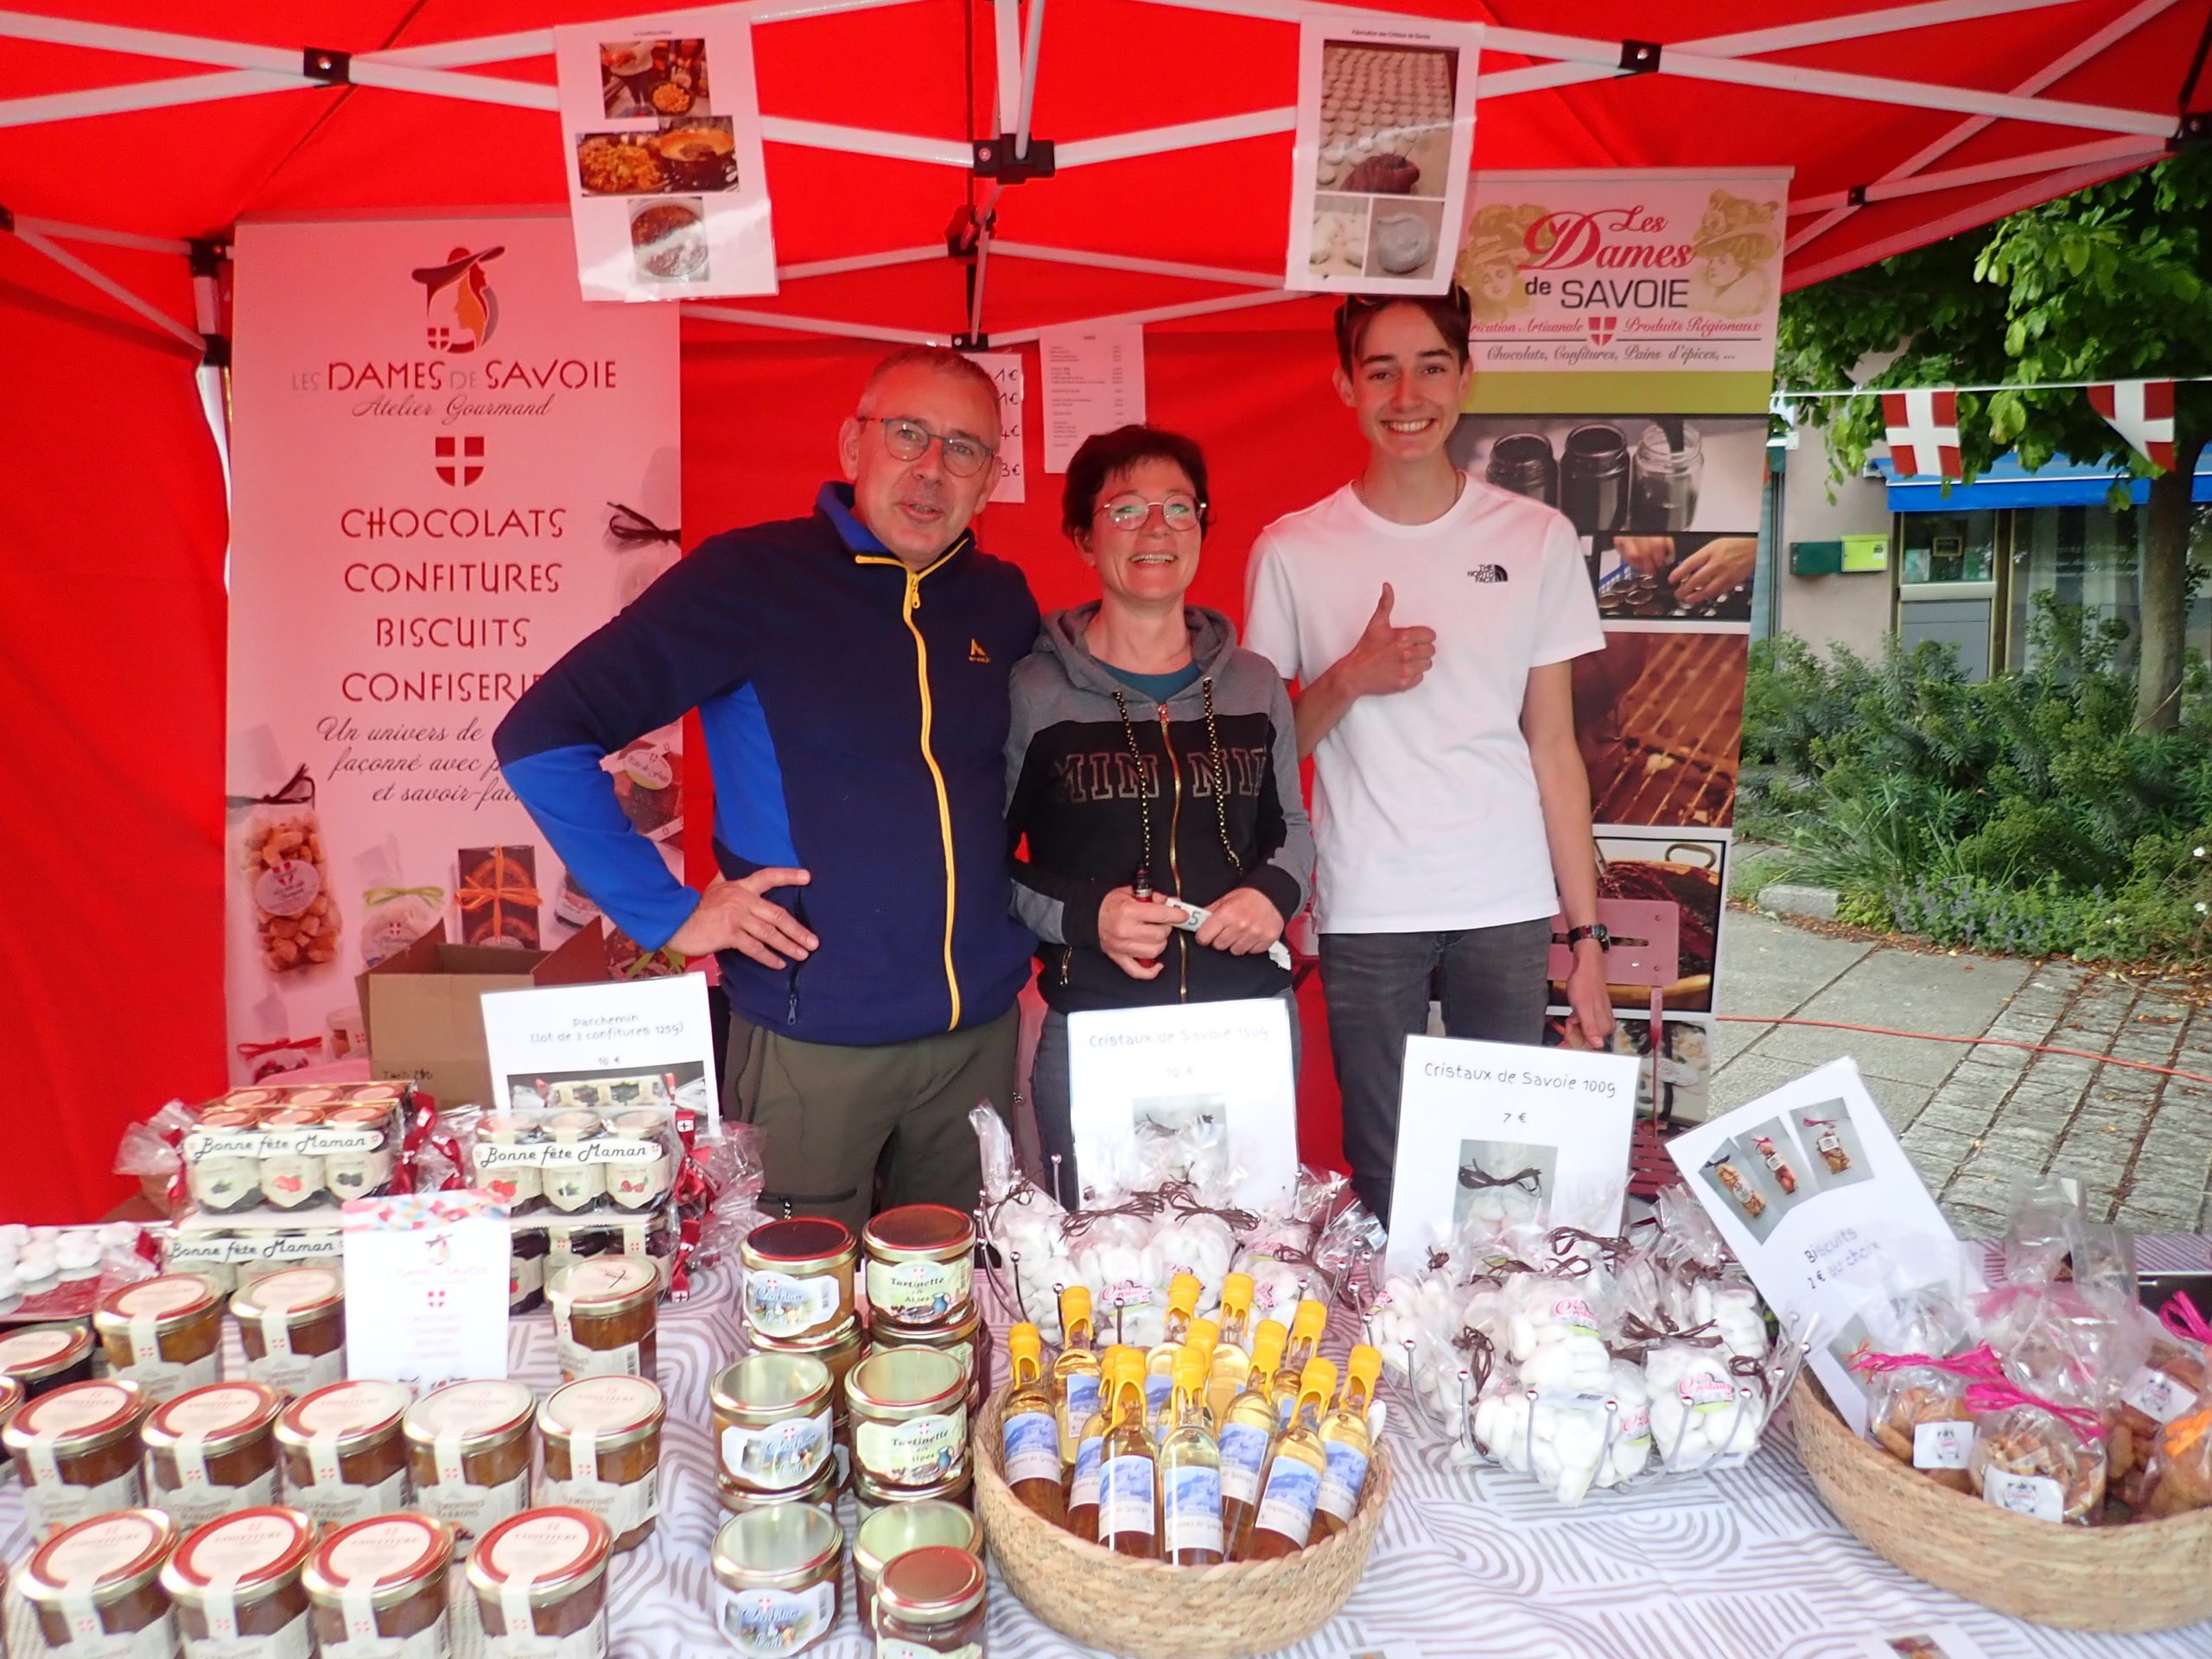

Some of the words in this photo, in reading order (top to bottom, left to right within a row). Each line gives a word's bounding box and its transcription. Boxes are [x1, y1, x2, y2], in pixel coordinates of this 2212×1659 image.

[1609, 206, 1669, 232] Les
[1518, 211, 1698, 270] Dames
[1525, 276, 1551, 296] de
[1561, 279, 1690, 309] SAVOIE
[1469, 321, 1516, 334] rication
[1623, 317, 1683, 333] Produits
[1686, 316, 1762, 338] Régionaux
[1624, 345, 1662, 360] Pains
[292, 373, 321, 391] LES
[328, 361, 446, 391] DAMES
[449, 372, 477, 390] DE
[486, 359, 616, 390] SAVOIE
[352, 394, 435, 416] Atelier
[442, 394, 556, 425] Gourmand
[340, 507, 567, 539] CHOCOLATS
[344, 563, 563, 594] CONFITURES
[377, 618, 531, 649] BISCUITS
[317, 717, 358, 741] Un
[367, 723, 448, 741] univers
[457, 717, 484, 741] de
[327, 747, 421, 780] façonné
[429, 757, 482, 772] avec
[372, 783, 396, 802] et
[573, 1014, 639, 1028] Parchemin
[1090, 1033, 1151, 1048] Cristaux
[1425, 1062, 1491, 1081] Cristaux
[1497, 1071, 1516, 1084] de
[1522, 1071, 1576, 1090] Savoie
[1583, 1079, 1616, 1098] 100g
[1503, 1113, 1511, 1123] 7
[1518, 1112, 1527, 1123] €
[194, 1137, 251, 1161] Bonne
[258, 1138, 289, 1159] fête
[296, 1135, 366, 1156] Maman
[481, 1147, 535, 1168] Bonne
[541, 1147, 573, 1166] fête
[578, 1143, 647, 1163] Maman
[171, 1242, 221, 1259] Bonne
[225, 1242, 257, 1262] fête
[264, 1239, 334, 1257] Maman
